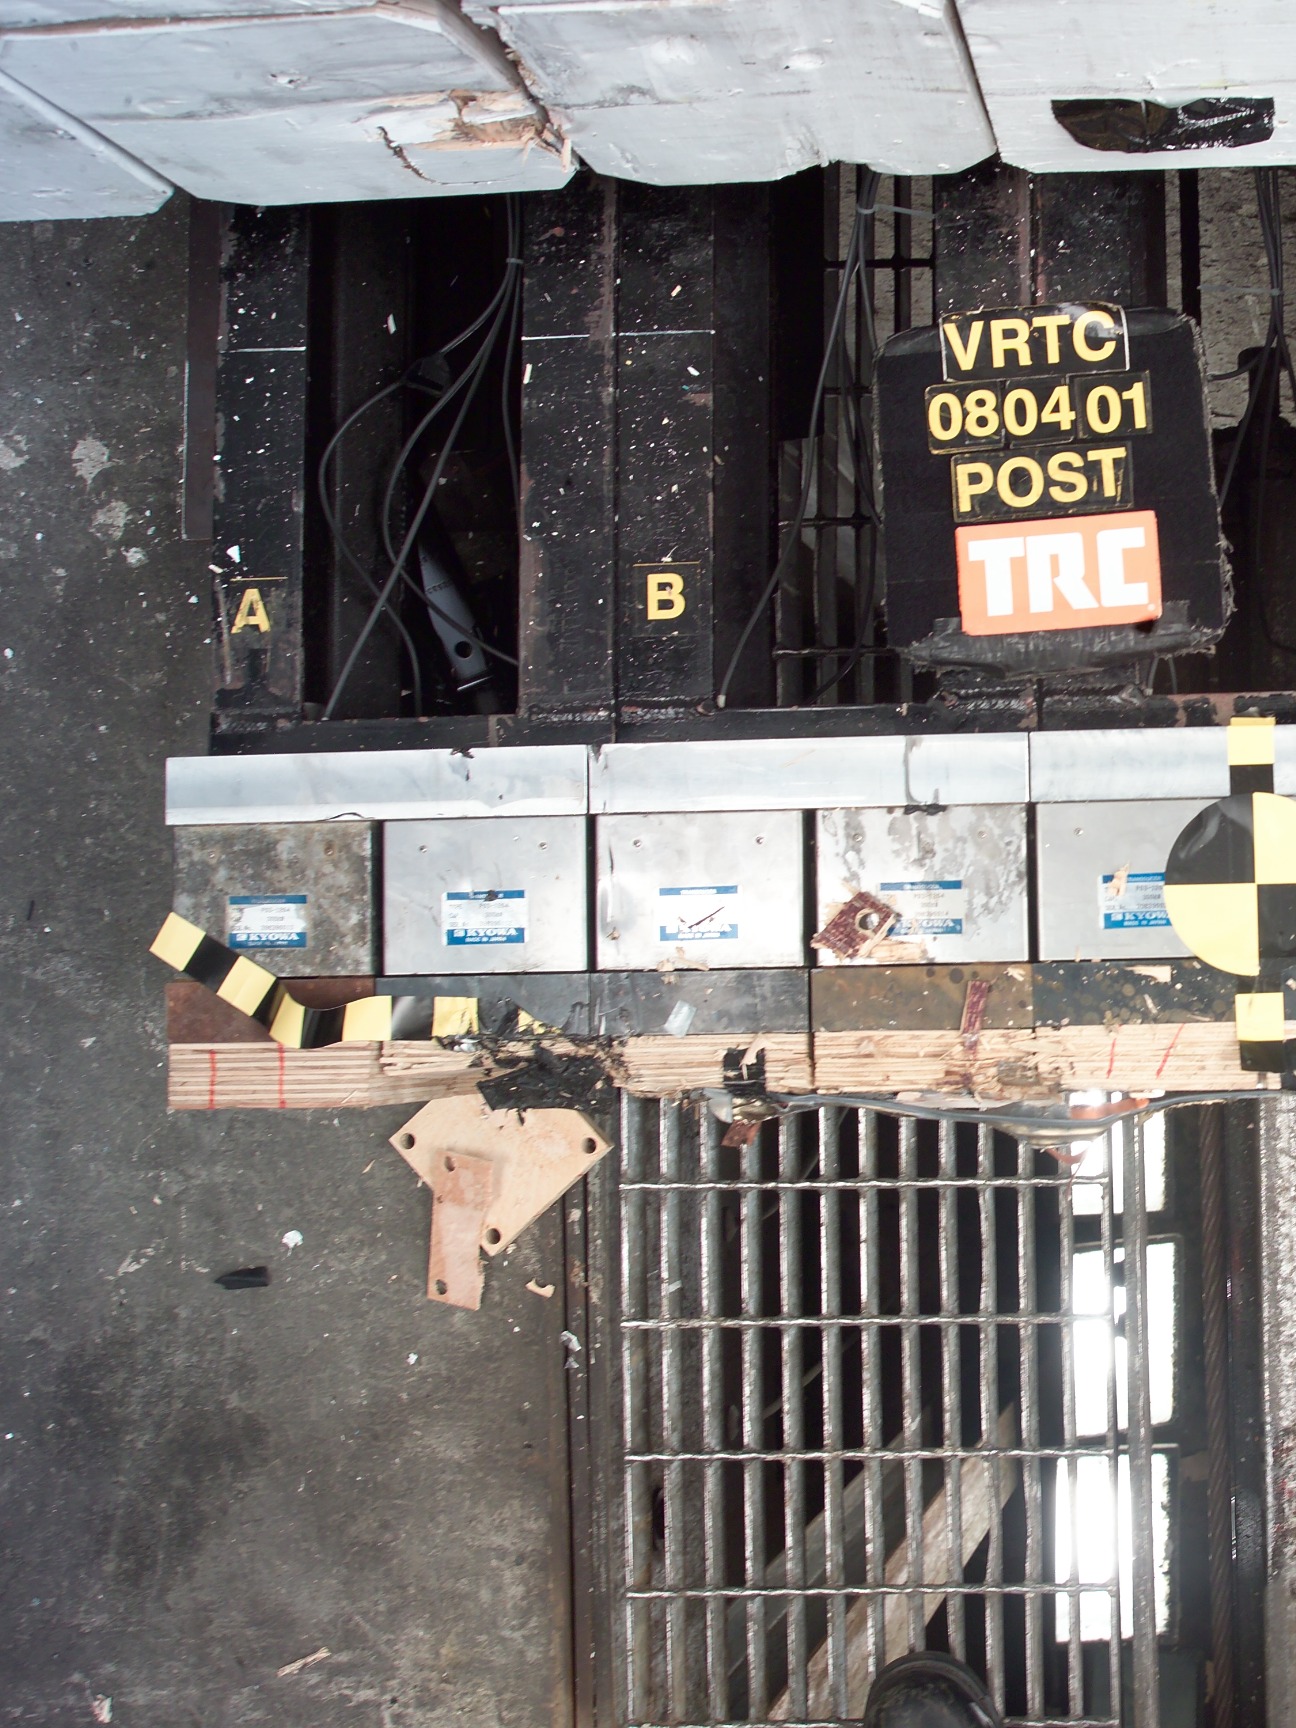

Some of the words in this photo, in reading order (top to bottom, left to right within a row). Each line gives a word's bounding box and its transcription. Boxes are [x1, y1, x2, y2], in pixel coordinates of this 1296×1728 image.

[943, 311, 1117, 371] VRTC
[956, 447, 1127, 513] POST
[967, 526, 1150, 617] TRC
[230, 588, 271, 634] A
[646, 573, 686, 621] B
[249, 932, 299, 941] KYOWA
[466, 928, 518, 937] KYOWA
[1124, 911, 1169, 920] KYOW
